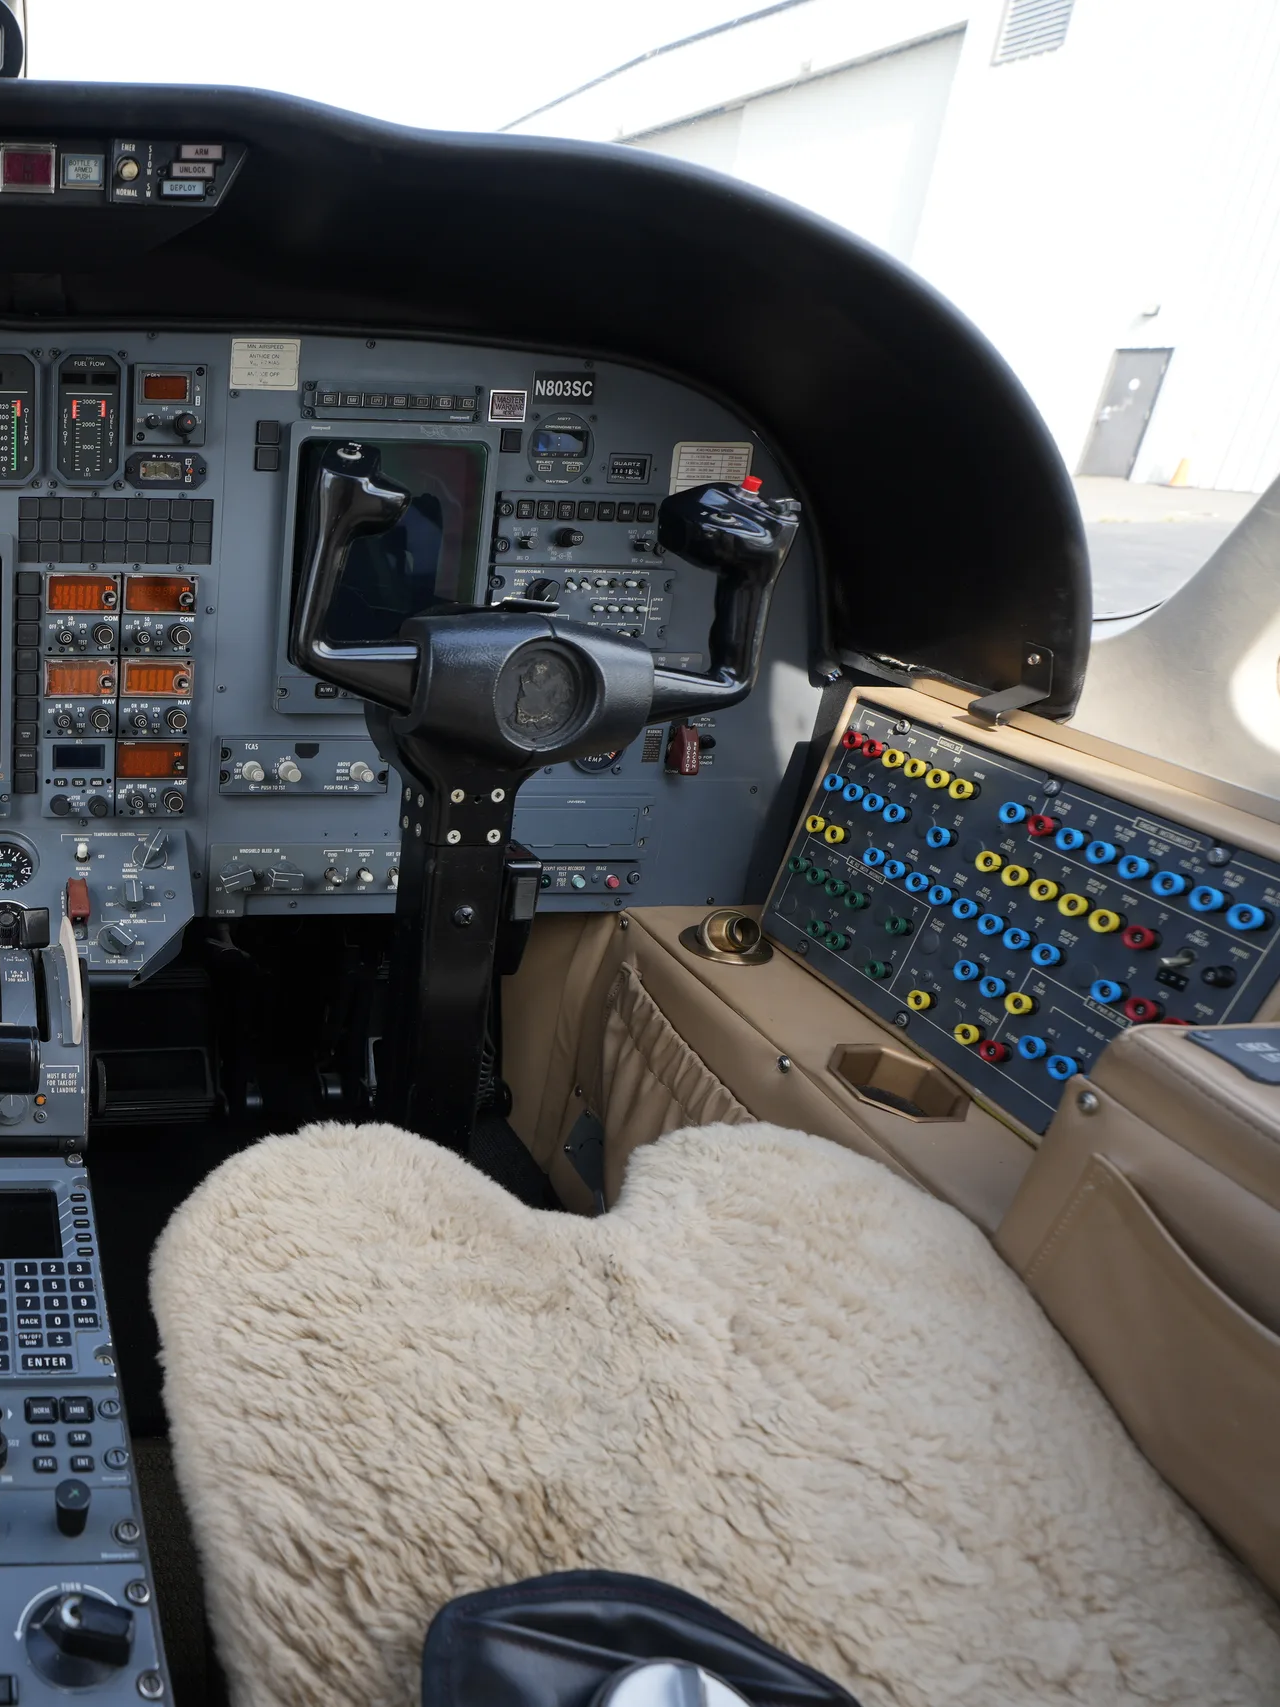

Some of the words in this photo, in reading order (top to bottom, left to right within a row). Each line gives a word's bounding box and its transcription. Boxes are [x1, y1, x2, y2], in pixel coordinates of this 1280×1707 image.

[121, 143, 135, 151] EMER
[116, 188, 137, 197] NORMAL
[535, 380, 592, 397] N803SC
[28, 1357, 66, 1366] ENTER
